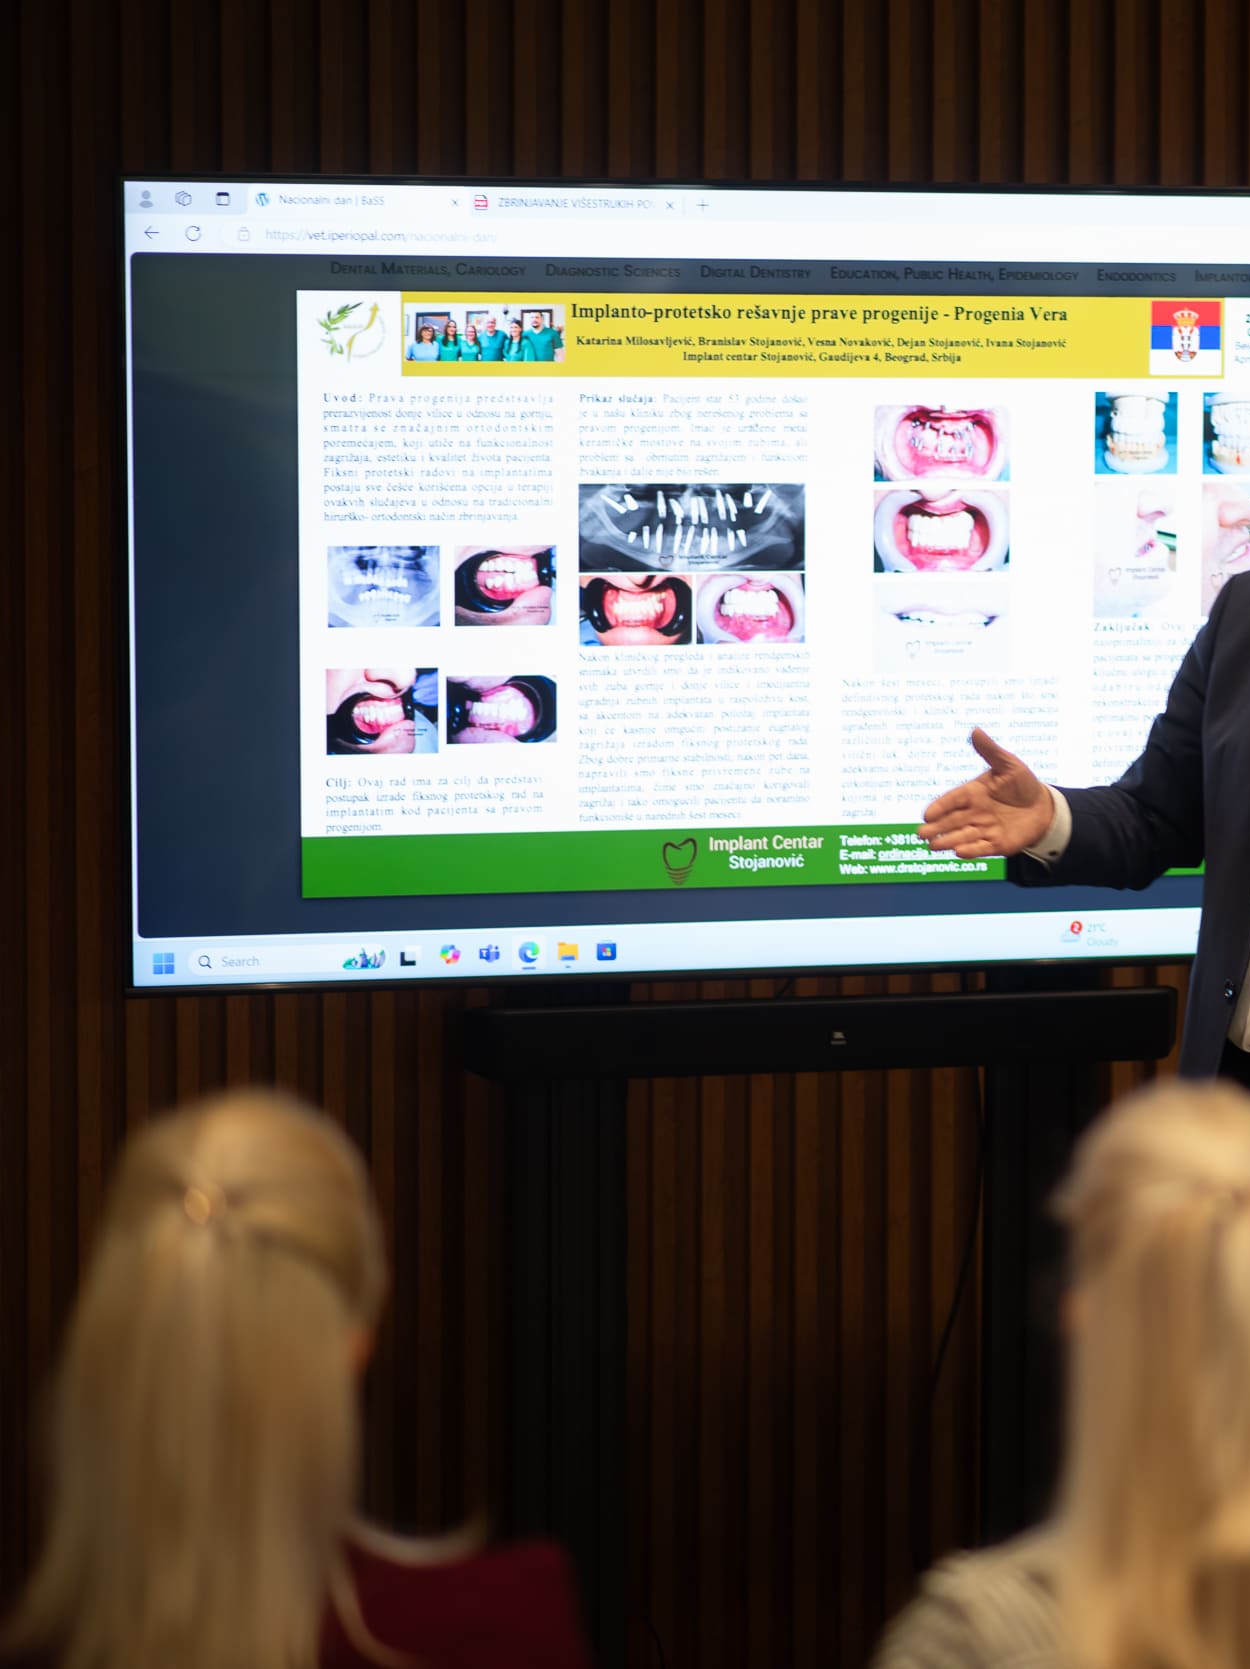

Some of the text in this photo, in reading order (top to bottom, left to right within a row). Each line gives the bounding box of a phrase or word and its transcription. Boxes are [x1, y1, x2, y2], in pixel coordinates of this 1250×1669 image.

[279, 194, 330, 206] Nacionalni
[571, 303, 732, 323] Implanto-protetsko
[737, 305, 806, 324] rešavnje
[811, 308, 857, 324] prave
[862, 307, 939, 325] progenije
[954, 306, 1025, 325] Progenia
[1029, 307, 1068, 321] Vera
[576, 335, 1067, 350] Katarina Milosavljević, Branislav Stojanović, Vesna Novaković, Dejan Stojanović, Ivana Stojanović
[683, 351, 724, 363] Implant
[726, 352, 758, 362] centar
[760, 351, 816, 364] Stojanović,
[819, 352, 870, 364] Gaudijeva
[885, 353, 929, 364] Beograd,
[932, 353, 962, 364] Srbija
[323, 393, 361, 403] Uvod:
[368, 393, 405, 403] Prava
[579, 393, 612, 403] Prikaz
[459, 440, 472, 448] na
[323, 468, 358, 478] Fiksni
[364, 468, 414, 479] protetski
[461, 470, 475, 478] na
[365, 484, 382, 492] sve
[325, 777, 351, 788] Cilj:
[357, 777, 383, 788] Ovaj
[389, 776, 406, 786] rad
[437, 778, 449, 786] za
[477, 776, 489, 786] da
[325, 793, 370, 803] postupak
[412, 792, 449, 802] fiksnog
[454, 791, 505, 801] protetskog
[511, 790, 527, 799] rad
[401, 806, 421, 815] kod
[426, 805, 479, 816] pacijenta
[485, 806, 497, 814] sa
[708, 834, 825, 854] Implant Centar
[840, 834, 882, 846] Telefon:
[840, 848, 876, 860] E-mail:
[728, 853, 805, 872] Stojanović
[839, 862, 988, 876] Web: www.drstojanovic.co.rs
[220, 955, 260, 968] Search
